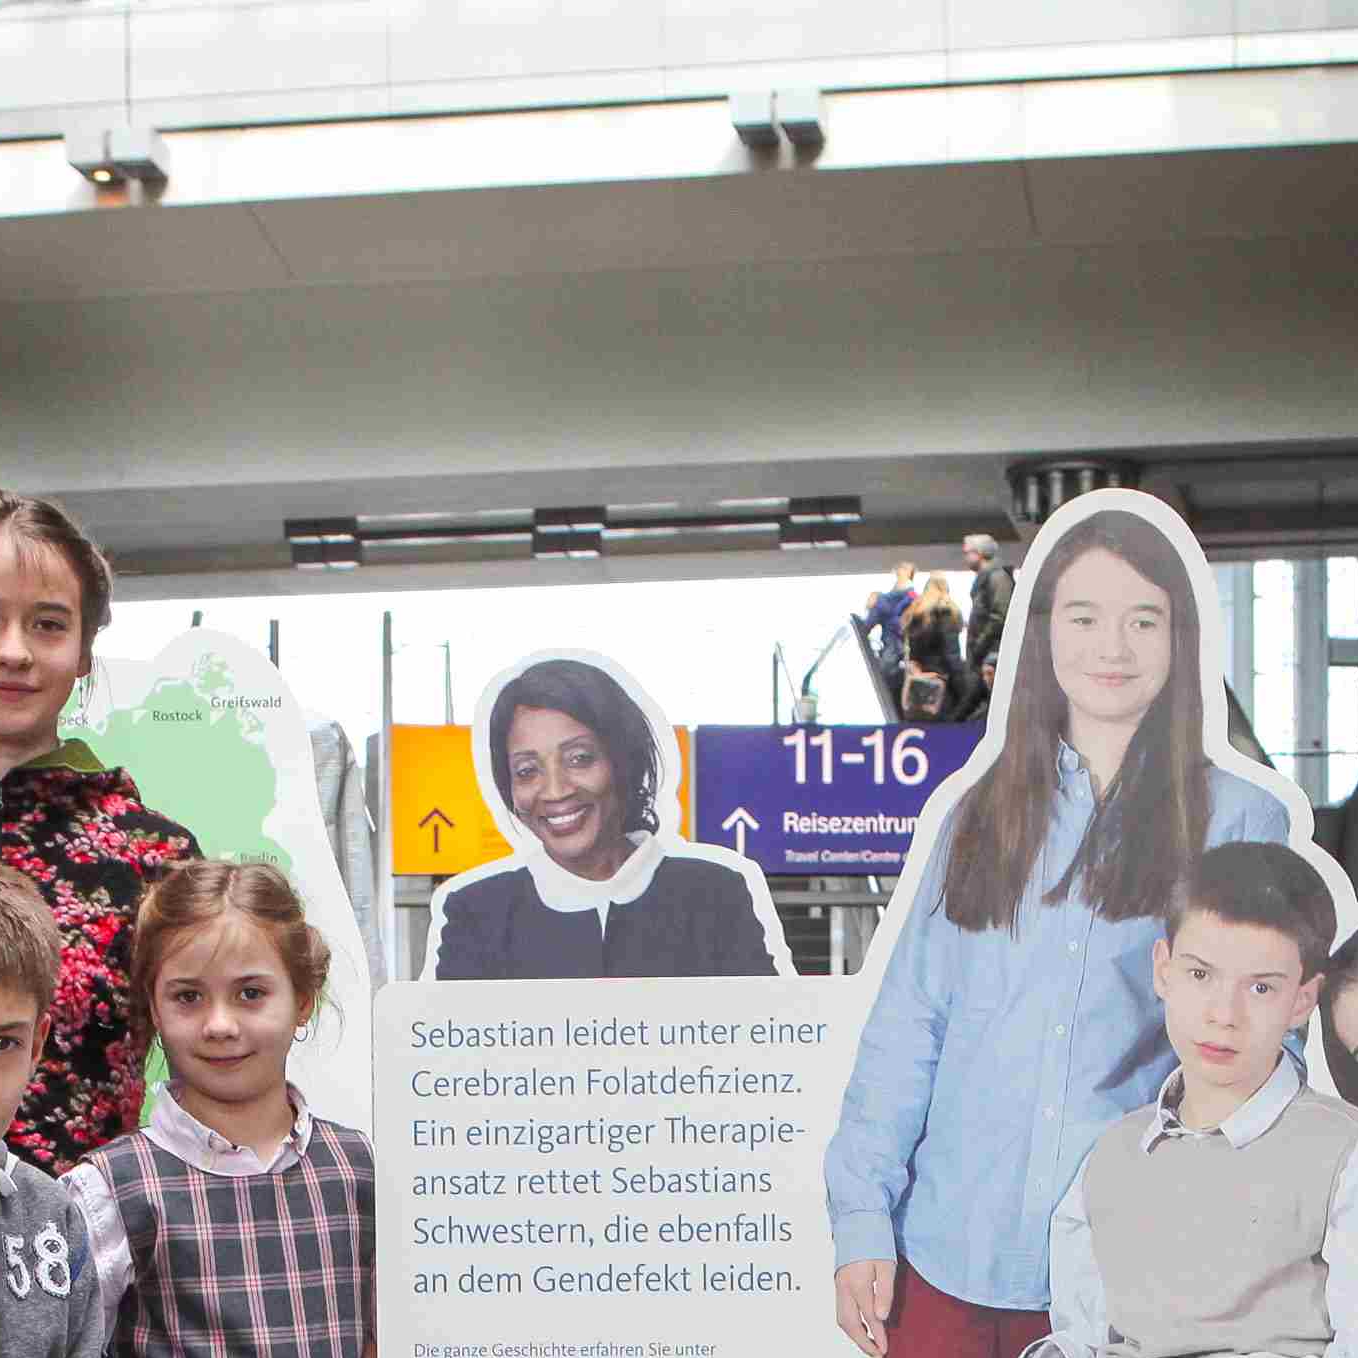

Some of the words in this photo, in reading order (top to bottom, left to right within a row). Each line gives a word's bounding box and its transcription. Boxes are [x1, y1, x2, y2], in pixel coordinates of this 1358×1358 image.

[152, 710, 203, 722] Rostock
[210, 695, 282, 709] Greifswald
[783, 728, 929, 785] 11-16
[410, 1019, 554, 1049] Sebastian
[565, 1016, 650, 1047] leidet
[658, 1020, 742, 1046] unter
[749, 1017, 828, 1045] einer
[410, 1067, 576, 1098] Cerebralen
[586, 1065, 803, 1096] Folatdefizienz.
[412, 1119, 456, 1147] Ein
[465, 1117, 655, 1154] einzigartiger
[665, 1115, 806, 1152] Therapie-
[411, 1169, 507, 1196] ansatz
[515, 1168, 603, 1195] rettet
[610, 1164, 773, 1194] Sebastians
[412, 1216, 595, 1248] Schwestern,
[602, 1215, 649, 1244] die
[657, 1212, 793, 1243] ebenfalls
[3, 1221, 72, 1299] 58
[412, 1272, 450, 1294] an
[457, 1264, 523, 1294] dem
[531, 1264, 693, 1293] Gendefekt
[700, 1262, 802, 1292] leiden.
[413, 1342, 440, 1358] Die
[491, 1342, 576, 1358] Geschichte
[579, 1342, 644, 1357] erfahren
[648, 1342, 671, 1356] Sie
[674, 1342, 717, 1356] unter
